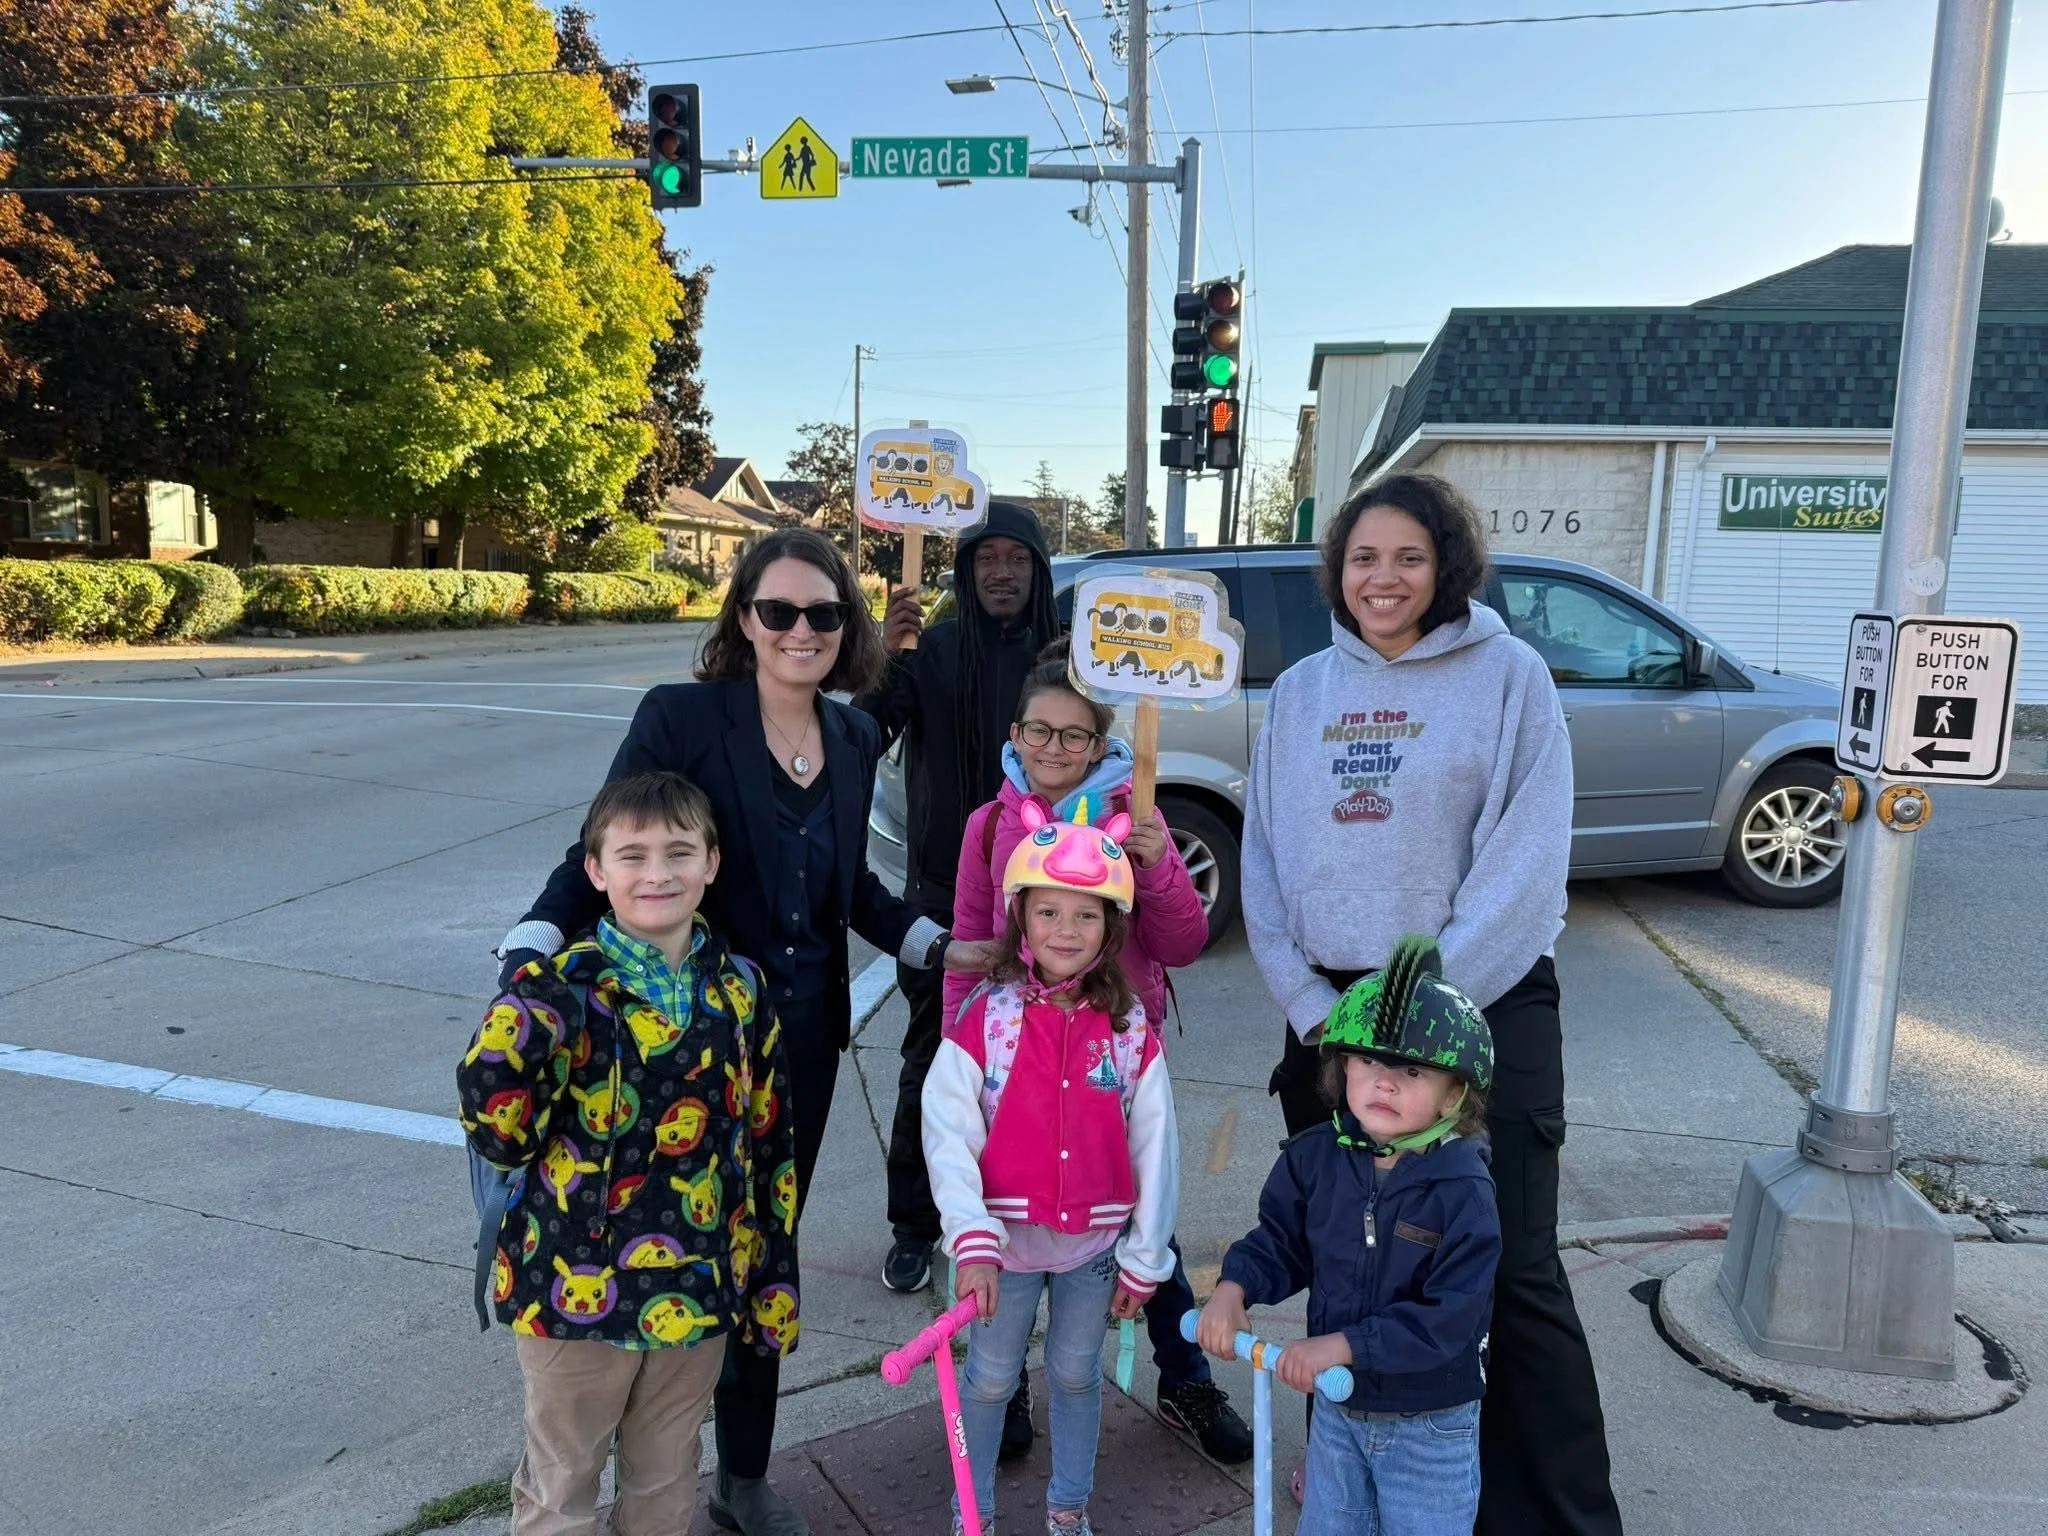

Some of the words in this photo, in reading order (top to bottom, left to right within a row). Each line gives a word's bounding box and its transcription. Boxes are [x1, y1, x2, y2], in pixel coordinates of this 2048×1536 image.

[864, 141, 970, 175] Nevada
[988, 142, 1014, 174] St
[1725, 477, 1886, 513] University
[1488, 509, 1582, 535] 1076
[1793, 504, 1882, 531] Suites
[1862, 625, 1881, 642] PUSH
[1930, 632, 1981, 649] PUSH
[1102, 636, 1132, 646] WALKING
[1133, 640, 1158, 649] SCHOOL
[1158, 643, 1171, 651] BUS
[1855, 646, 1882, 663] BUTTON
[1916, 653, 1989, 670] BUTTON
[1859, 666, 1874, 683] FOR
[1931, 674, 1968, 691] FOR
[1341, 712, 1366, 725] I'm
[1372, 709, 1408, 724] the
[1322, 721, 1426, 742] Mommy
[1347, 741, 1393, 757] that
[1332, 755, 1403, 775] Really
[1341, 773, 1391, 790] Don't
[1335, 796, 1391, 819] Play-Doh
